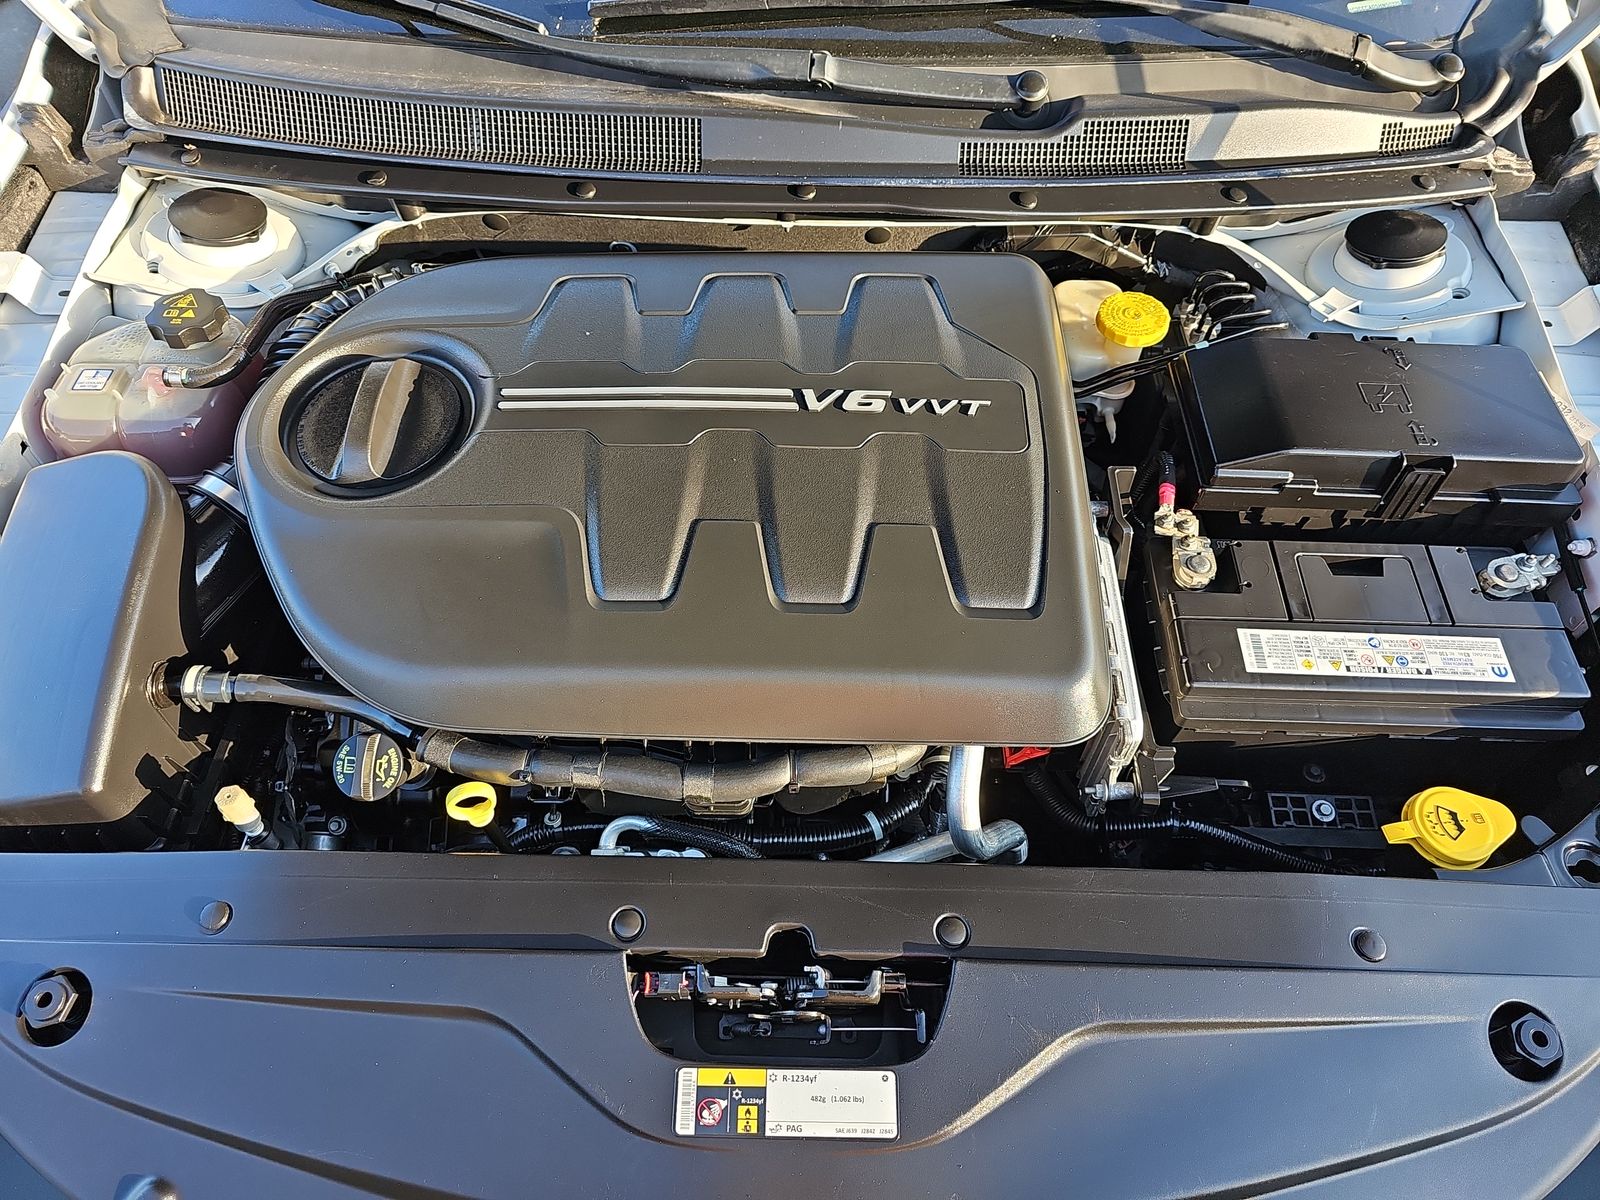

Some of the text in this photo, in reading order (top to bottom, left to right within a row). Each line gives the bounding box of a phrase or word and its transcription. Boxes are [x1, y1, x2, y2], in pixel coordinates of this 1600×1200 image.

[801, 388, 992, 416] V6 VVT
[335, 745, 350, 784] SAE 5W-20
[382, 747, 399, 789] ENGINE OIL
[782, 1074, 818, 1084] R-1234yf
[810, 1095, 865, 1103] 482g (1.062 lbs)
[786, 1124, 803, 1133] PAG
